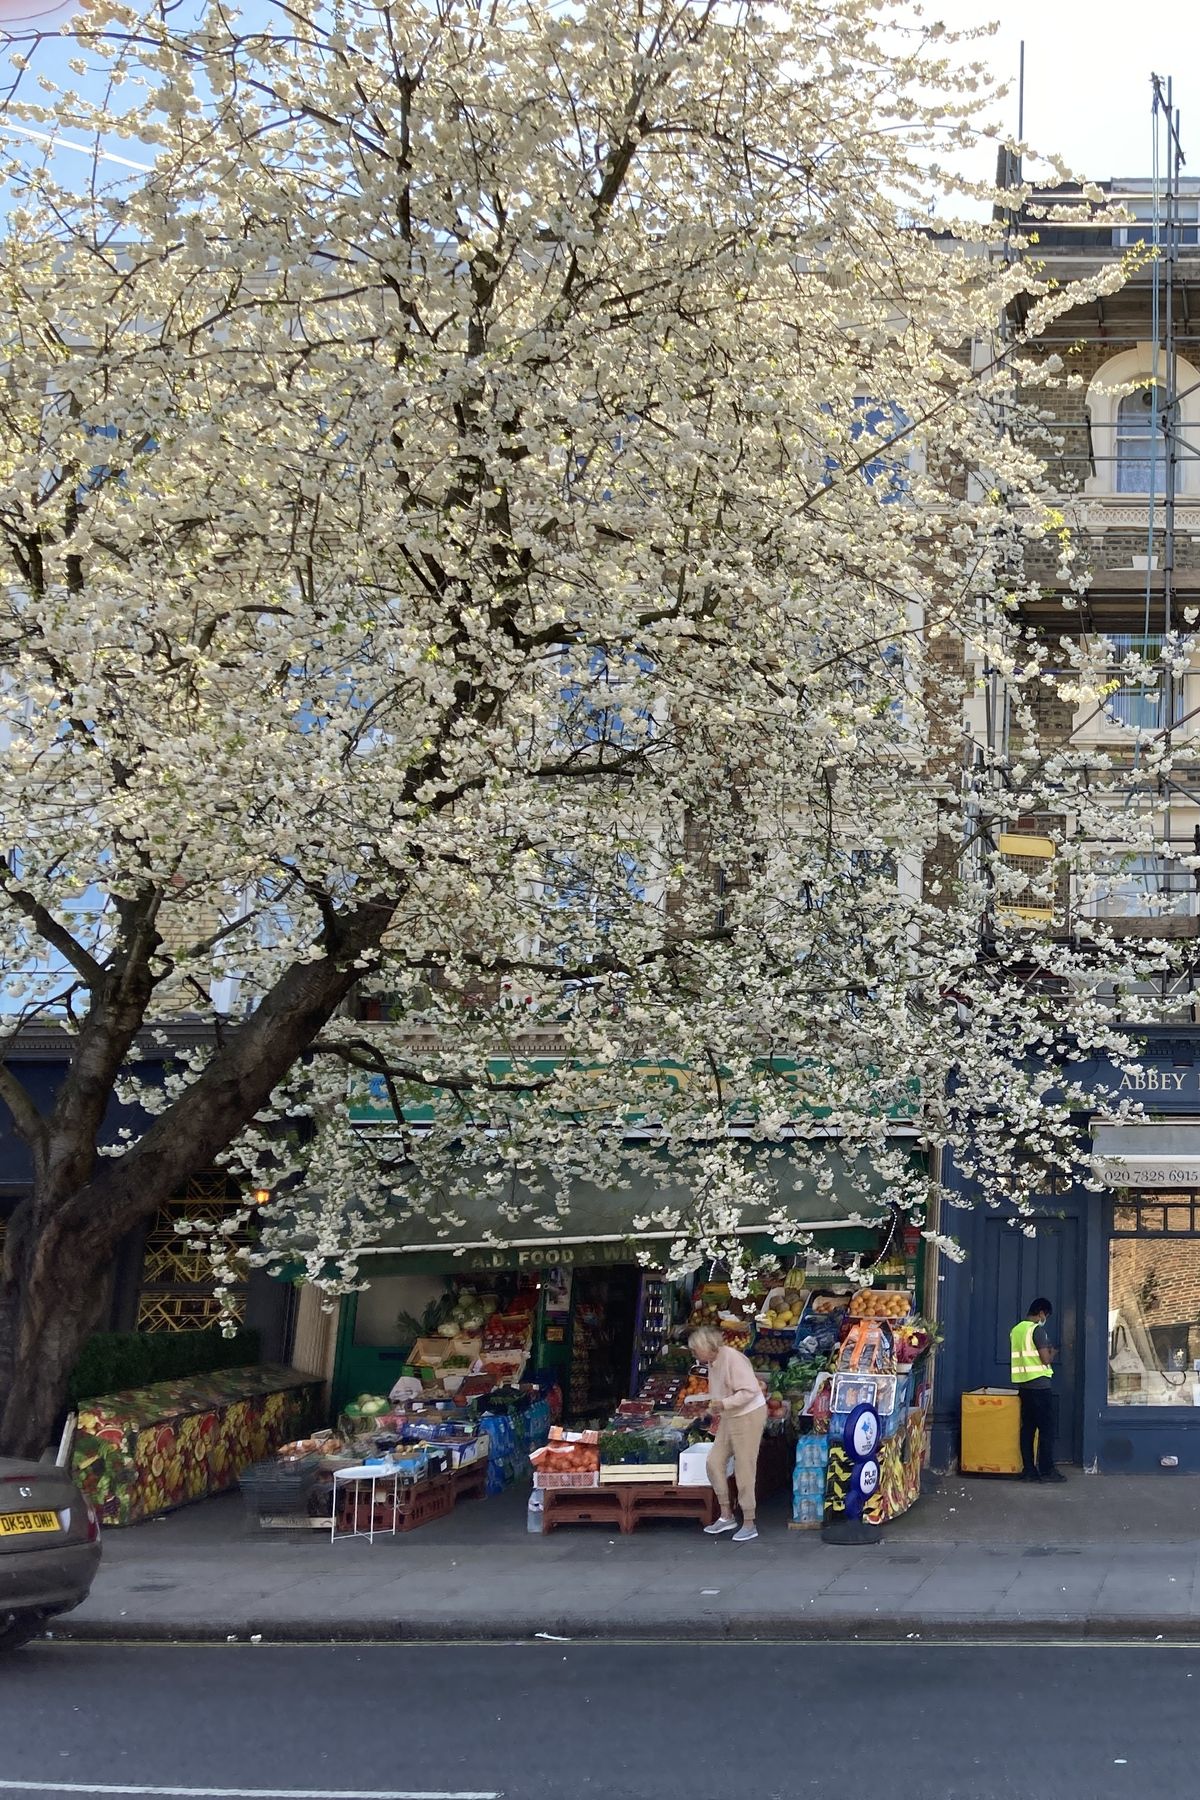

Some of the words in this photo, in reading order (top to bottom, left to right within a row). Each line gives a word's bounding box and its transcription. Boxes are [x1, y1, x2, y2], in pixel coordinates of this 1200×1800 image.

[1118, 1073, 1188, 1091] ABBEY
[1104, 1170, 1130, 1182] 020
[1133, 1169, 1165, 1183] 7328
[1168, 1169, 1199, 1183] 6915
[518, 1248, 575, 1266] FOOD
[1, 1514, 33, 1532] DK58
